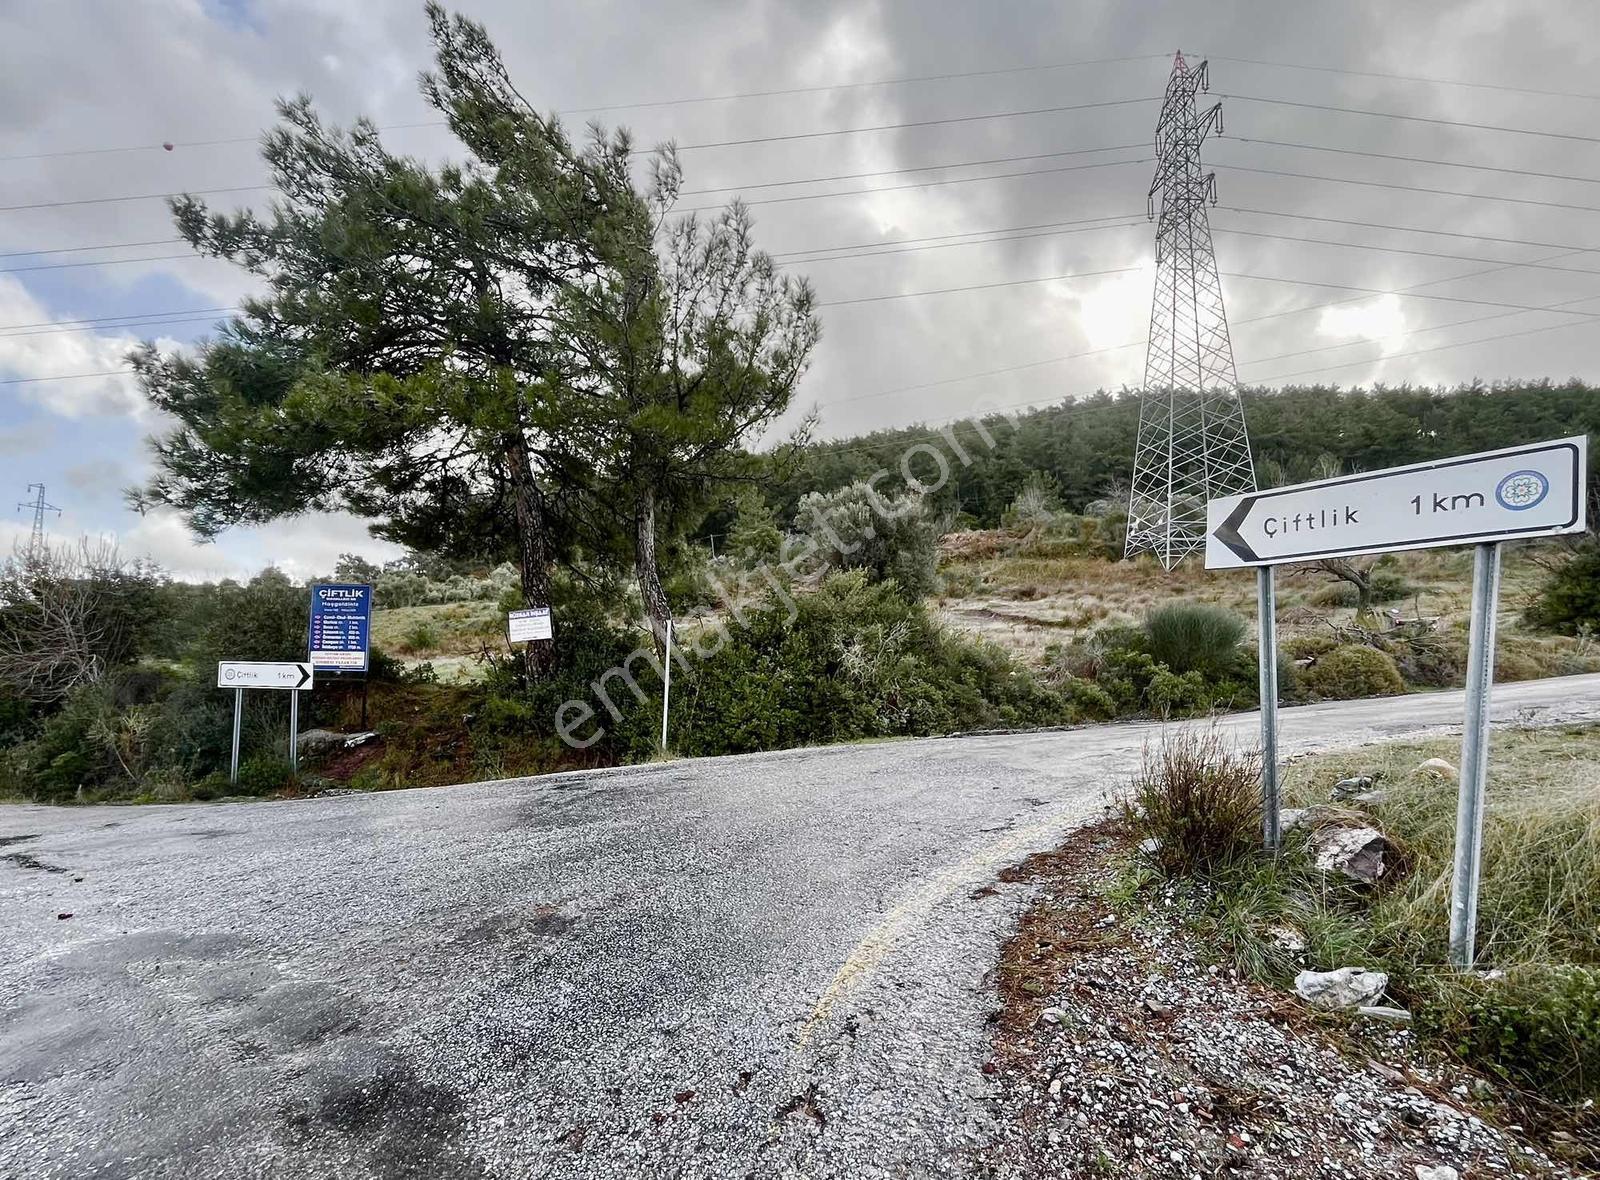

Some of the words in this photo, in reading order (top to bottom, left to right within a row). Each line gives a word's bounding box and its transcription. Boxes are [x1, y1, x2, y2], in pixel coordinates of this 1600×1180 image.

[1264, 506, 1359, 538] Çiftlik
[1411, 495, 1420, 515] 1
[1433, 492, 1484, 512] km
[319, 588, 364, 599] ÇİFTLİK
